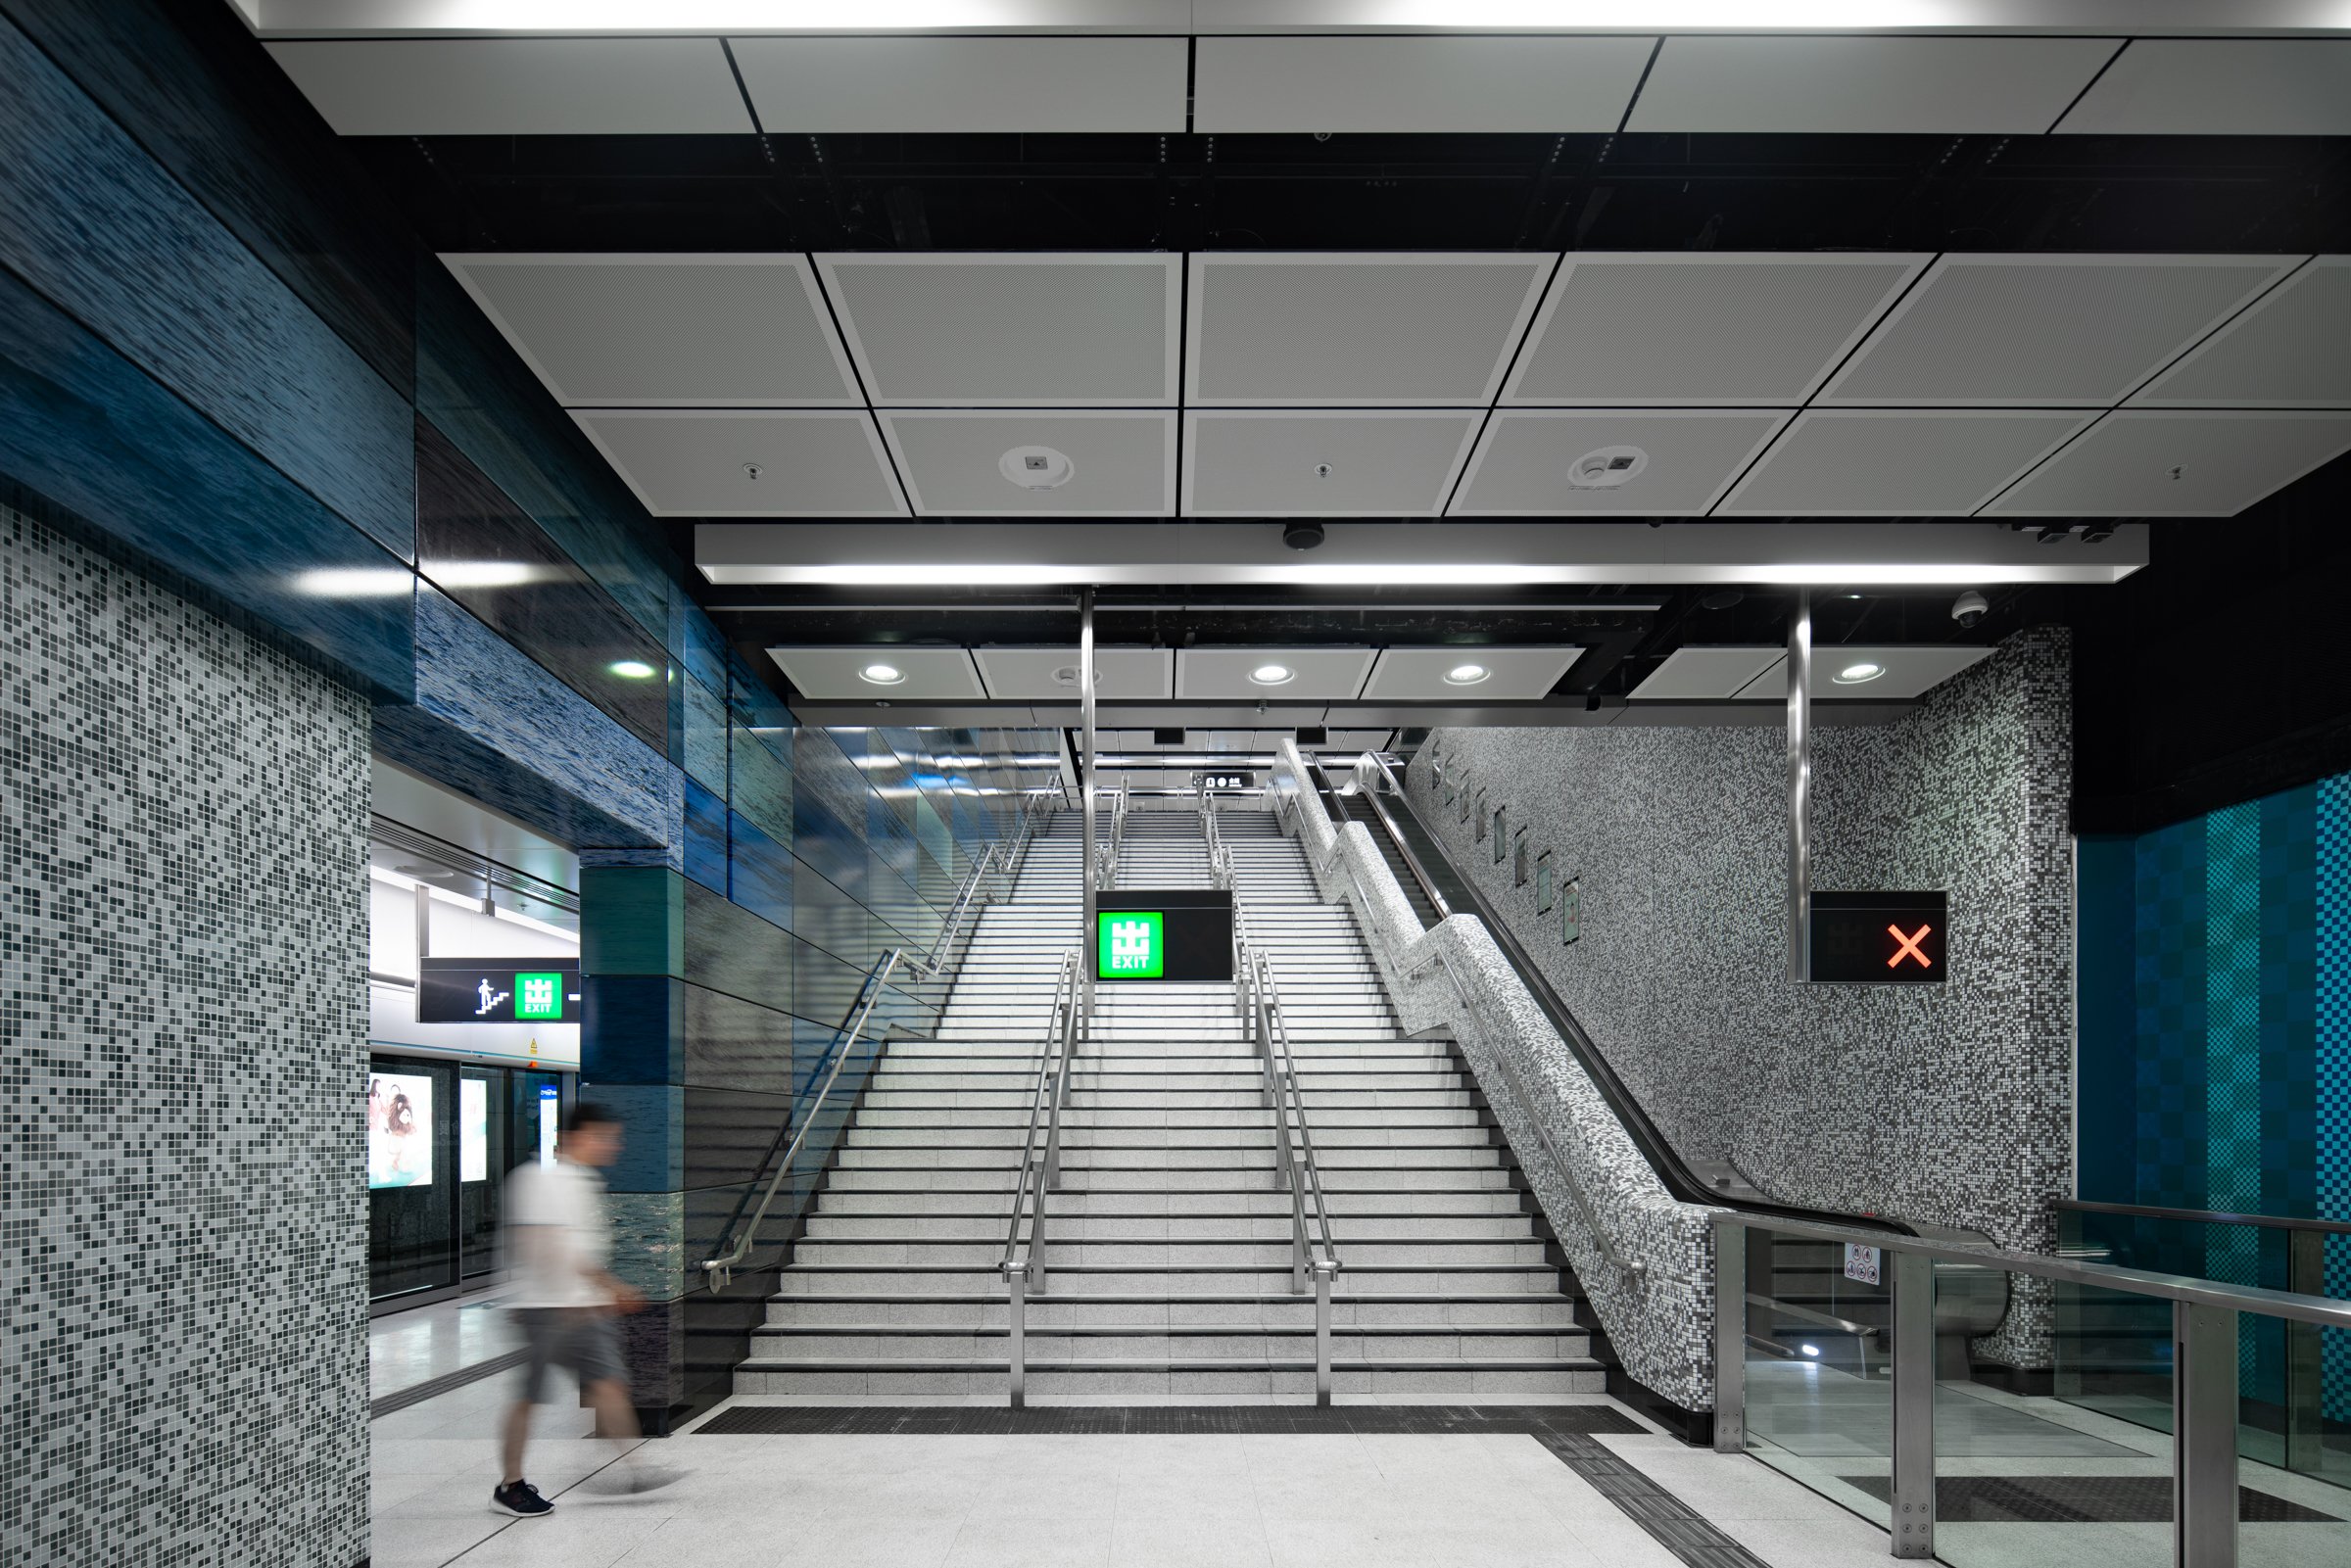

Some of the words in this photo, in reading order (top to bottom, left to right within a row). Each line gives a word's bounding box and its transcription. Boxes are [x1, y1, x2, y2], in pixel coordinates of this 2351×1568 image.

[1112, 921, 1149, 955] 出
[1112, 956, 1149, 969] EXIT
[525, 979, 552, 1003] 出
[524, 1003, 552, 1013] EXIT
